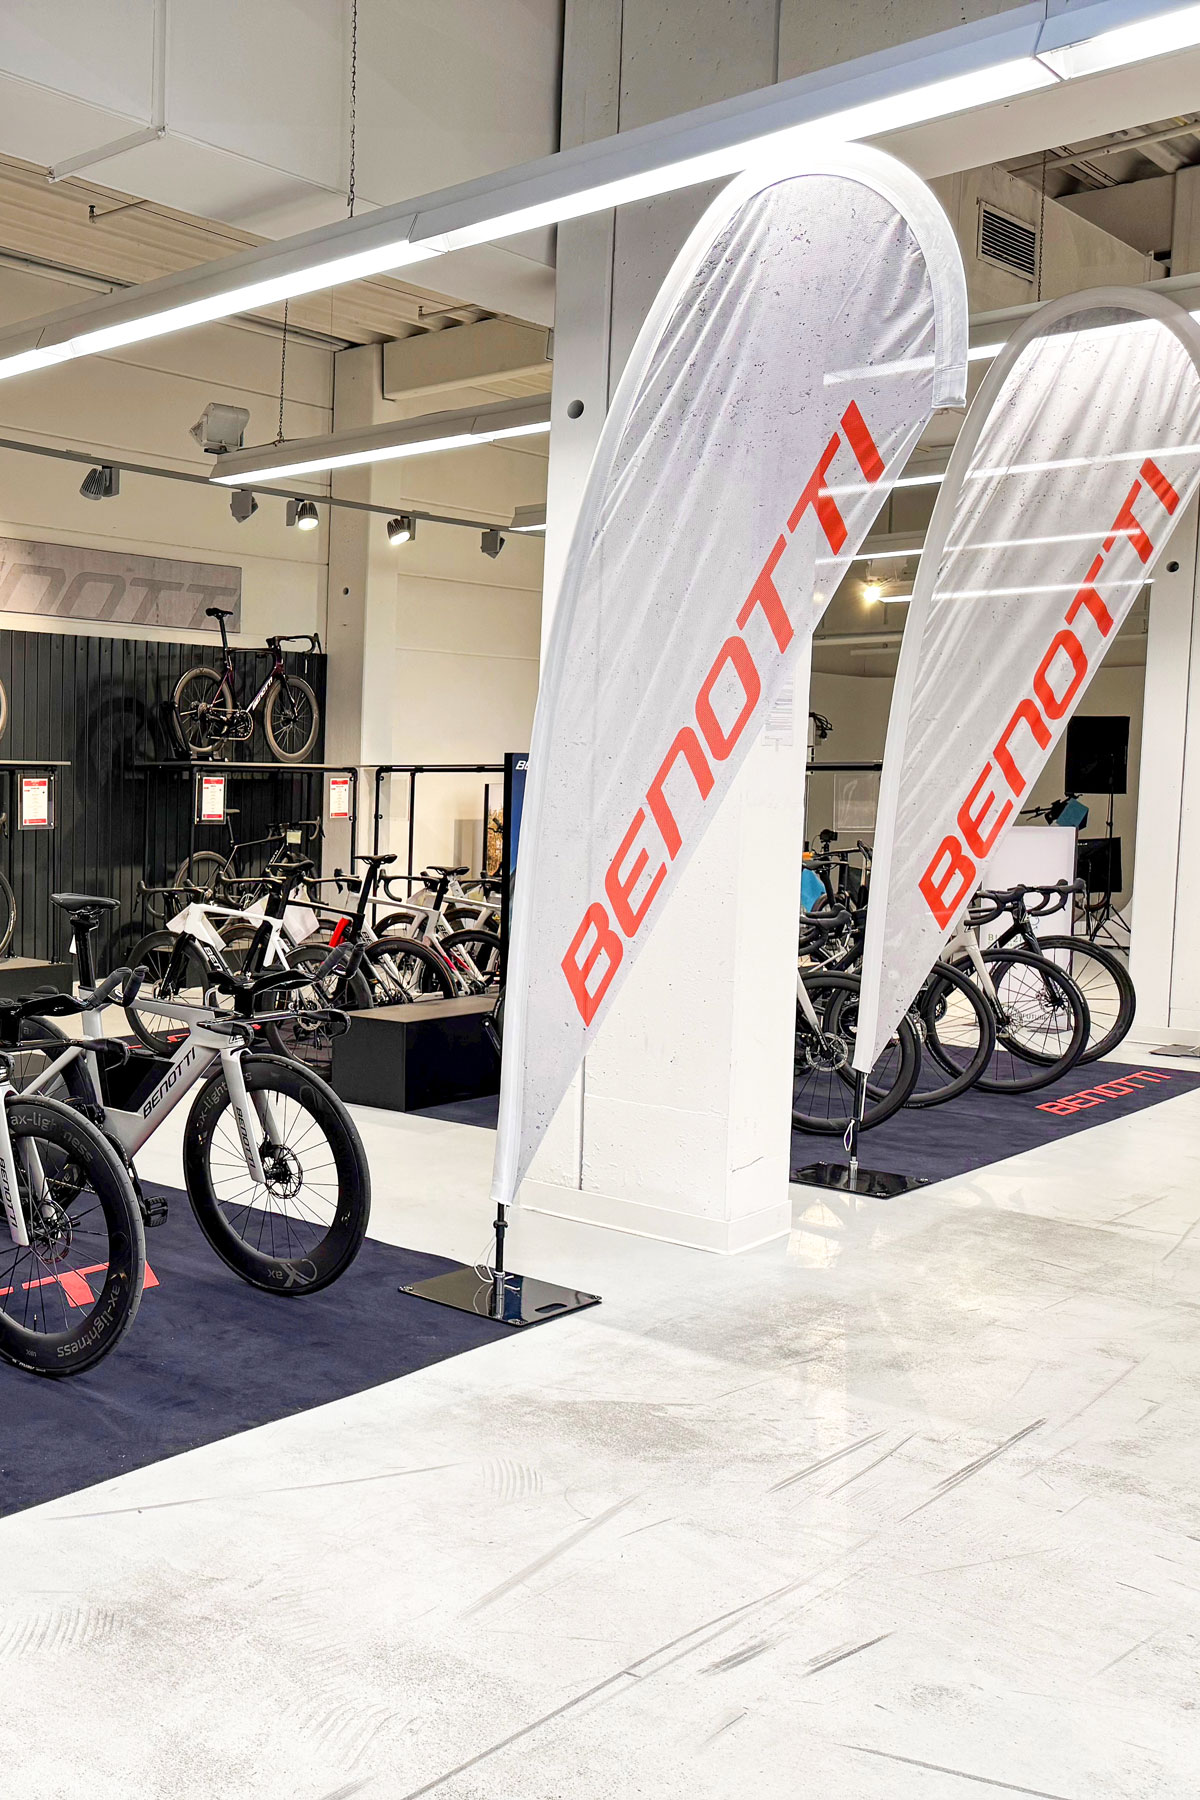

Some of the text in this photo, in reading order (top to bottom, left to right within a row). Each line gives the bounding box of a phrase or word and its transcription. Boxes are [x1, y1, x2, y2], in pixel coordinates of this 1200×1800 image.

[561, 400, 885, 1027] BENOTTI
[918, 457, 1180, 931] BENOTTI
[142, 1046, 195, 1120] BENOTTI
[1035, 1070, 1172, 1116] BENOTTI
[235, 1106, 256, 1169] BENOTTI
[56, 1284, 122, 1358] ax-lightness
